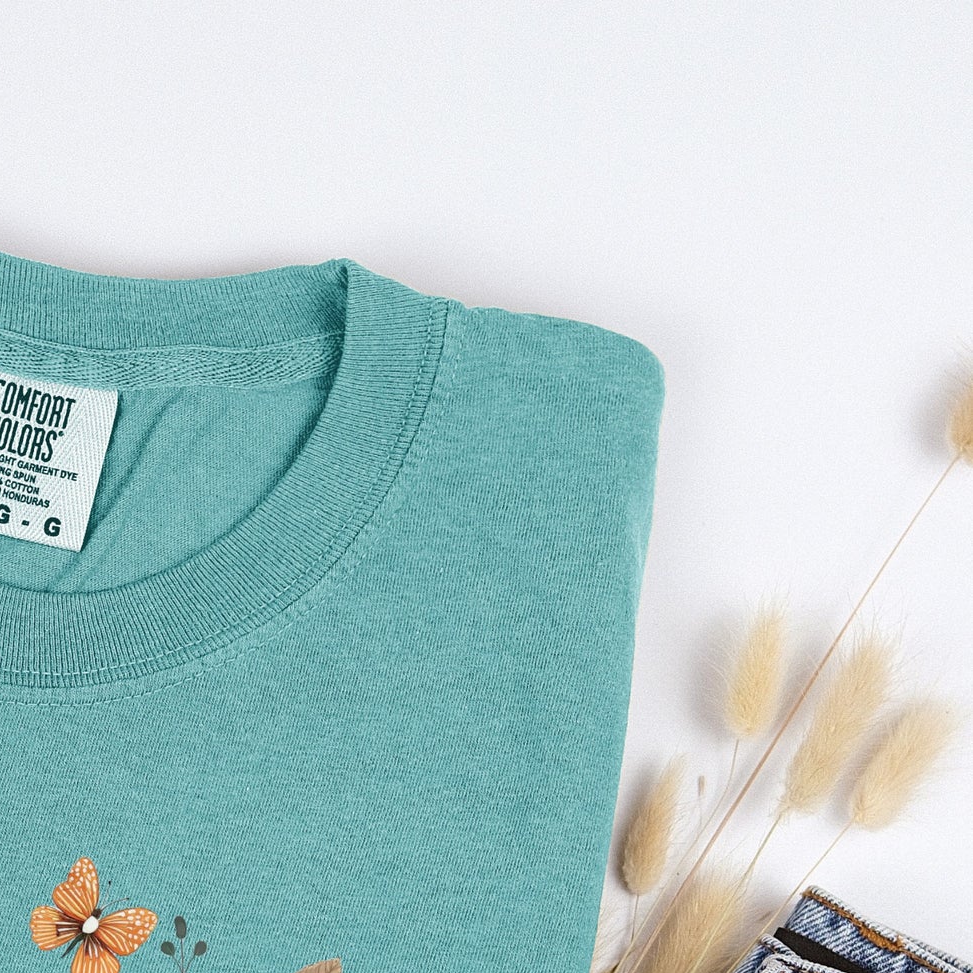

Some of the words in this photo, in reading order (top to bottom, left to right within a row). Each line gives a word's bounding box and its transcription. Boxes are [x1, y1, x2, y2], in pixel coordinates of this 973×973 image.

[12, 470, 36, 483] SPUN
[17, 460, 59, 477] GARMENT
[60, 470, 78, 481] DYE
[4, 479, 40, 494] COTTON
[2, 488, 50, 508] HONDURAS
[44, 517, 61, 537] G
